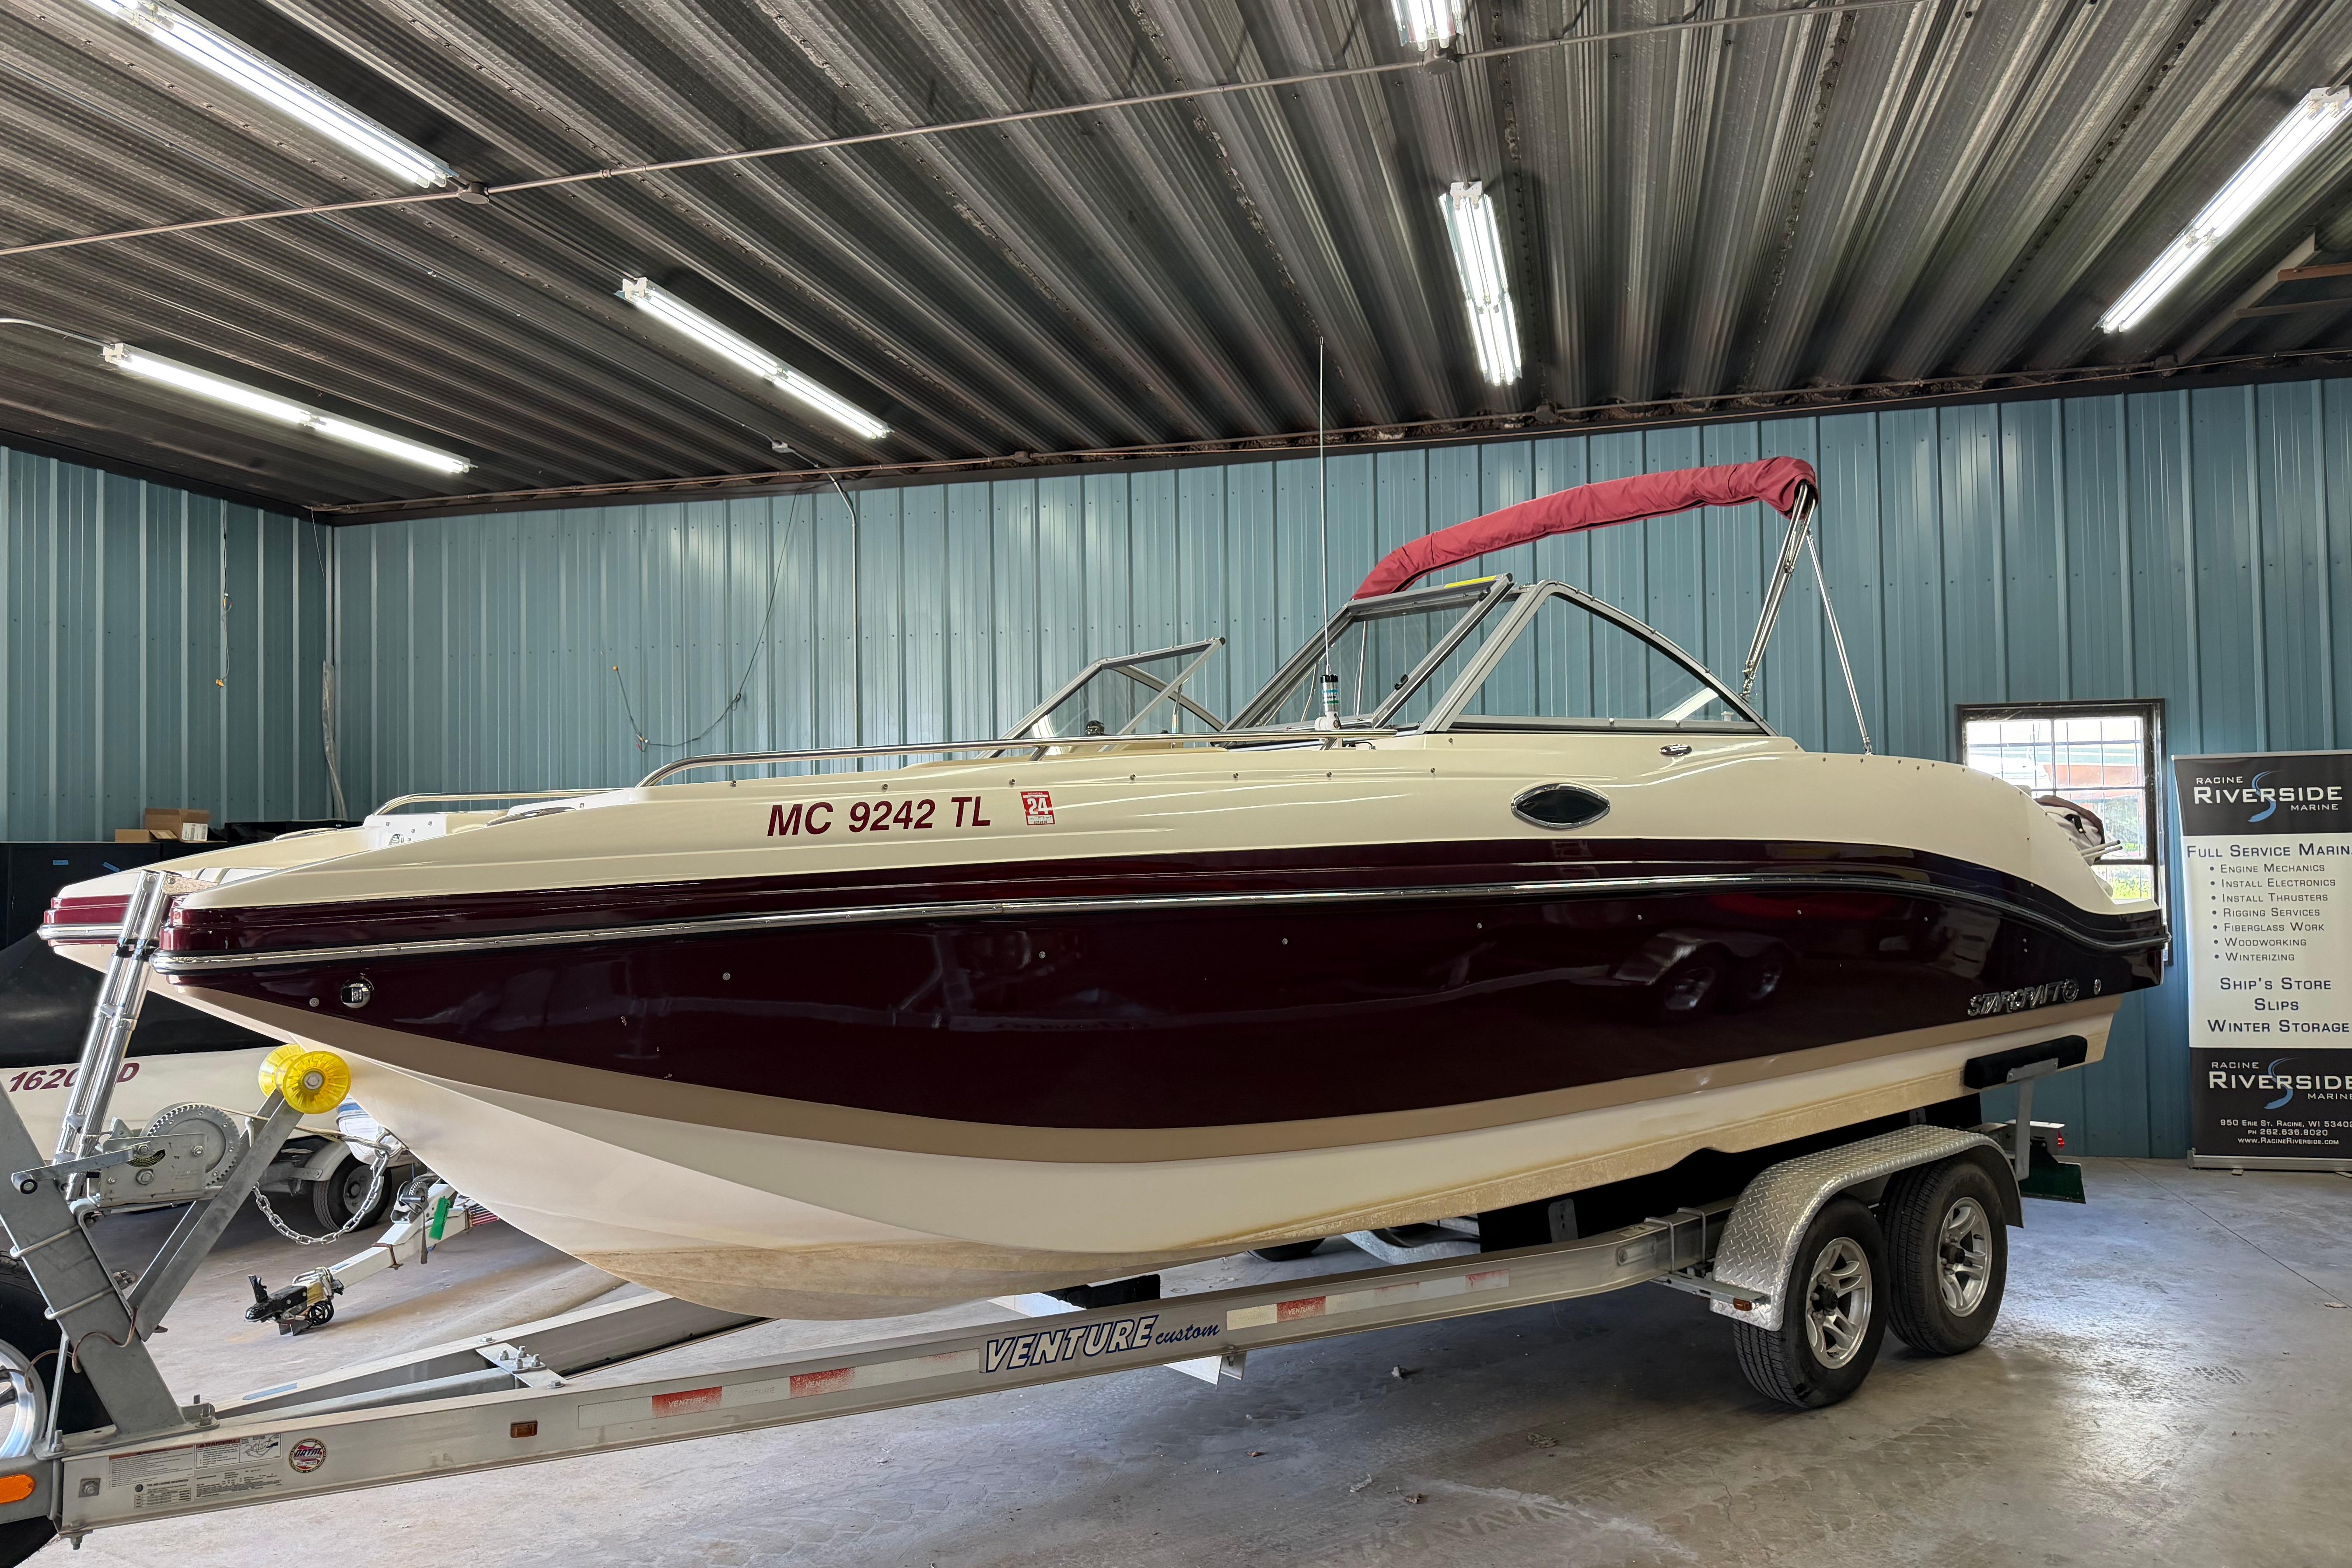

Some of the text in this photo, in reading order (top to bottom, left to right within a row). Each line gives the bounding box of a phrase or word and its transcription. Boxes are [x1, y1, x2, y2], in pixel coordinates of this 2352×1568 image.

[2193, 786, 2342, 804] RIVERSIDE
[1027, 798, 1052, 815] 24
[767, 796, 991, 837] MC 9242 TL
[2187, 843, 2352, 858] FULL SERVICE MARIN
[2221, 863, 2325, 873] ENGINE MECHANICS
[2222, 878, 2336, 888] INSTALL ELECTRONICS
[2223, 893, 2328, 902] INSTALL THRUSTERS
[2223, 908, 2320, 917] RIGGING SERVICES
[2224, 922, 2324, 931] FIBERGLASS WORK
[2224, 937, 2306, 946] WOODWORKING
[2225, 952, 2294, 961] WINTERIZING
[2220, 977, 2331, 990] SHIP'S STORE
[1967, 980, 2063, 1017] STARCRAFT
[2254, 998, 2299, 1010] SLIPS
[2207, 1020, 2349, 1032] WINTER STORAGE
[1288, 1304, 1316, 1315] VENTURE
[986, 1314, 1220, 1373] VENTURE custom
[668, 1396, 707, 1407] VENTURE
